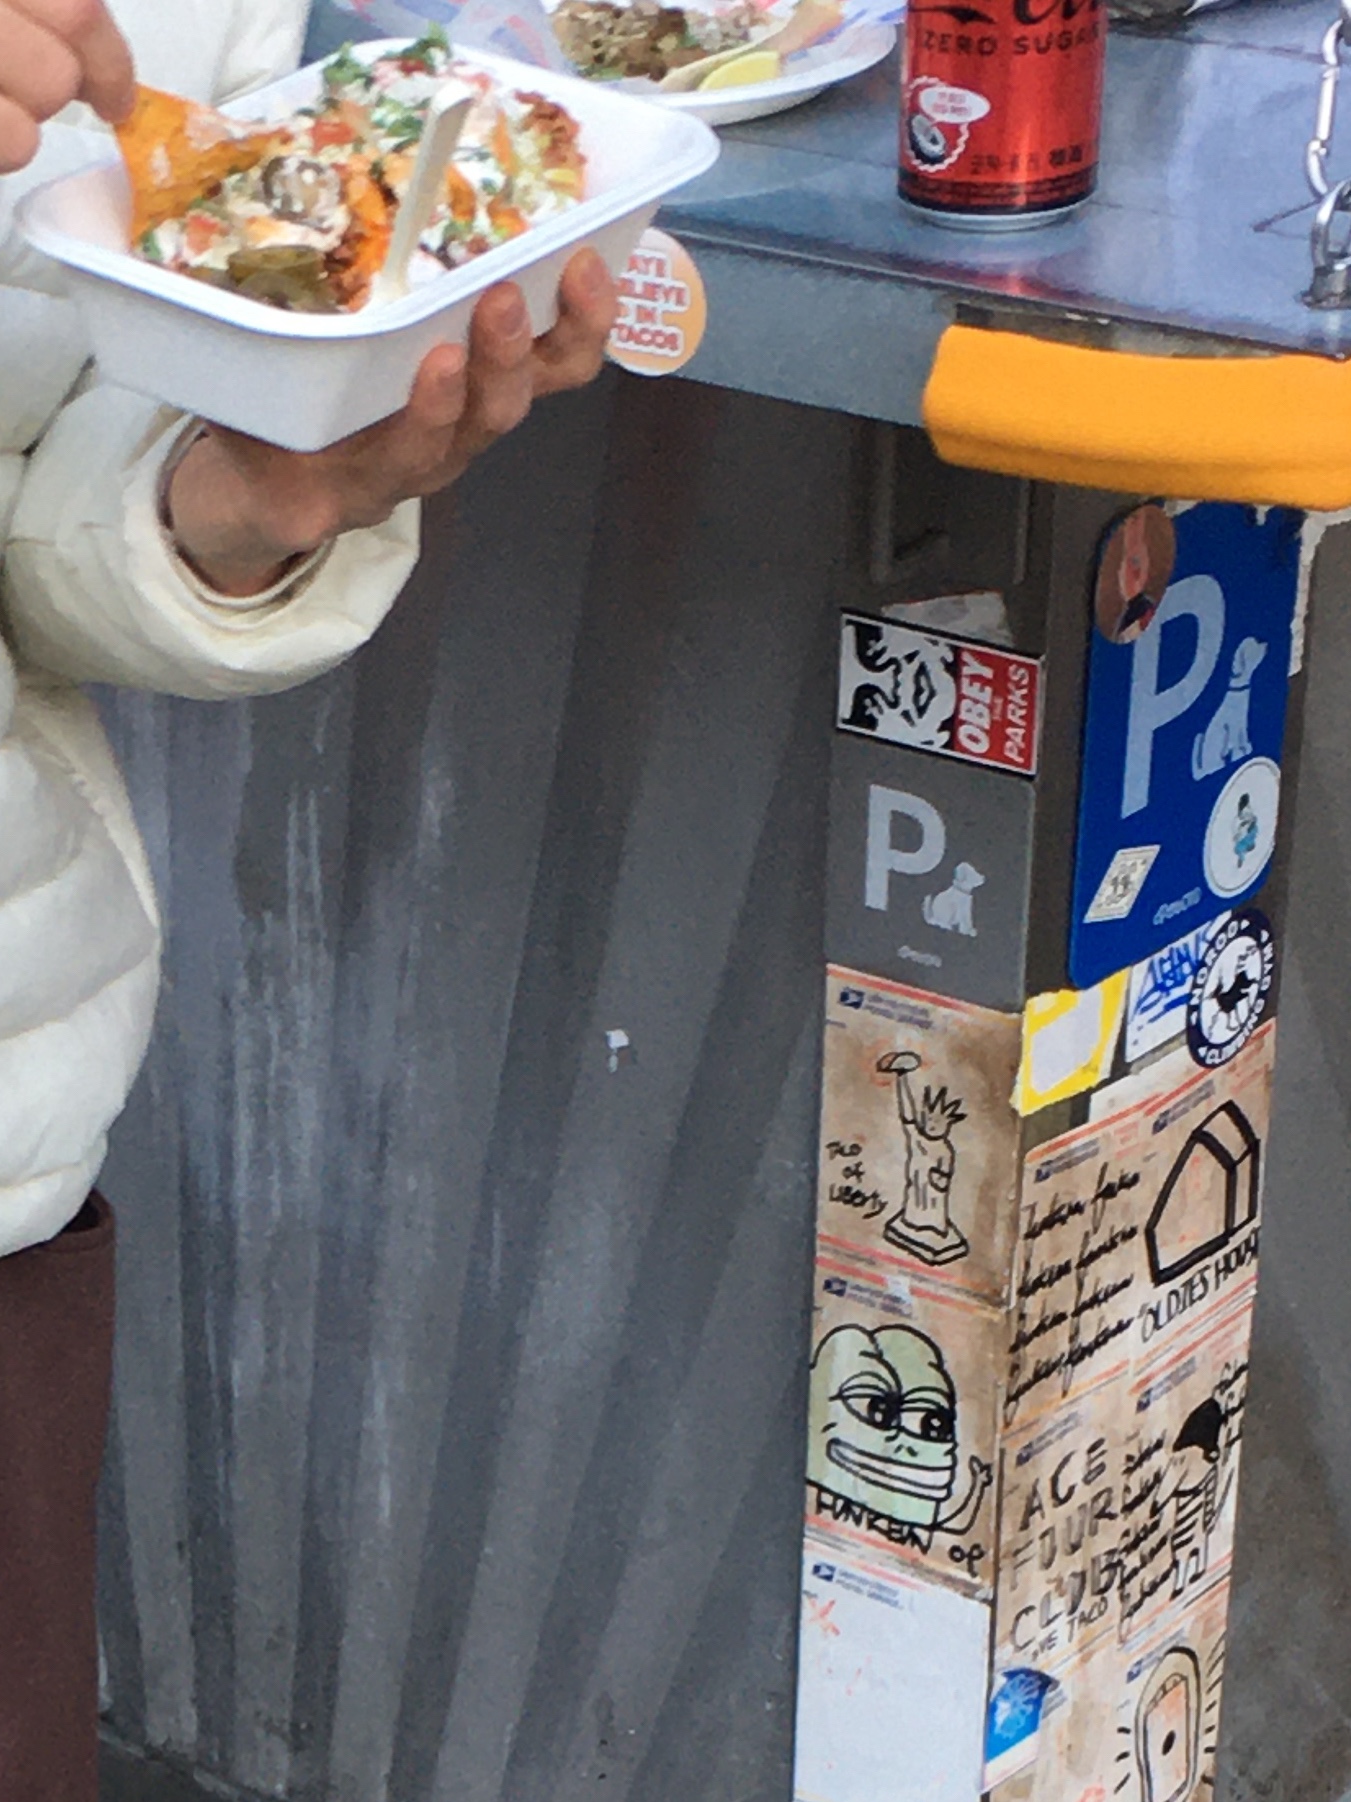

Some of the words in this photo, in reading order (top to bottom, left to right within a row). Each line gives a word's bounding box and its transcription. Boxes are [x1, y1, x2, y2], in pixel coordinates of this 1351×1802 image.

[912, 31, 996, 56] ZERO
[958, 651, 994, 754] OBEY
[1004, 664, 1029, 764] PARKS
[1121, 575, 1225, 819] P
[864, 784, 945, 912] P
[1017, 1437, 1109, 1532] ACE
